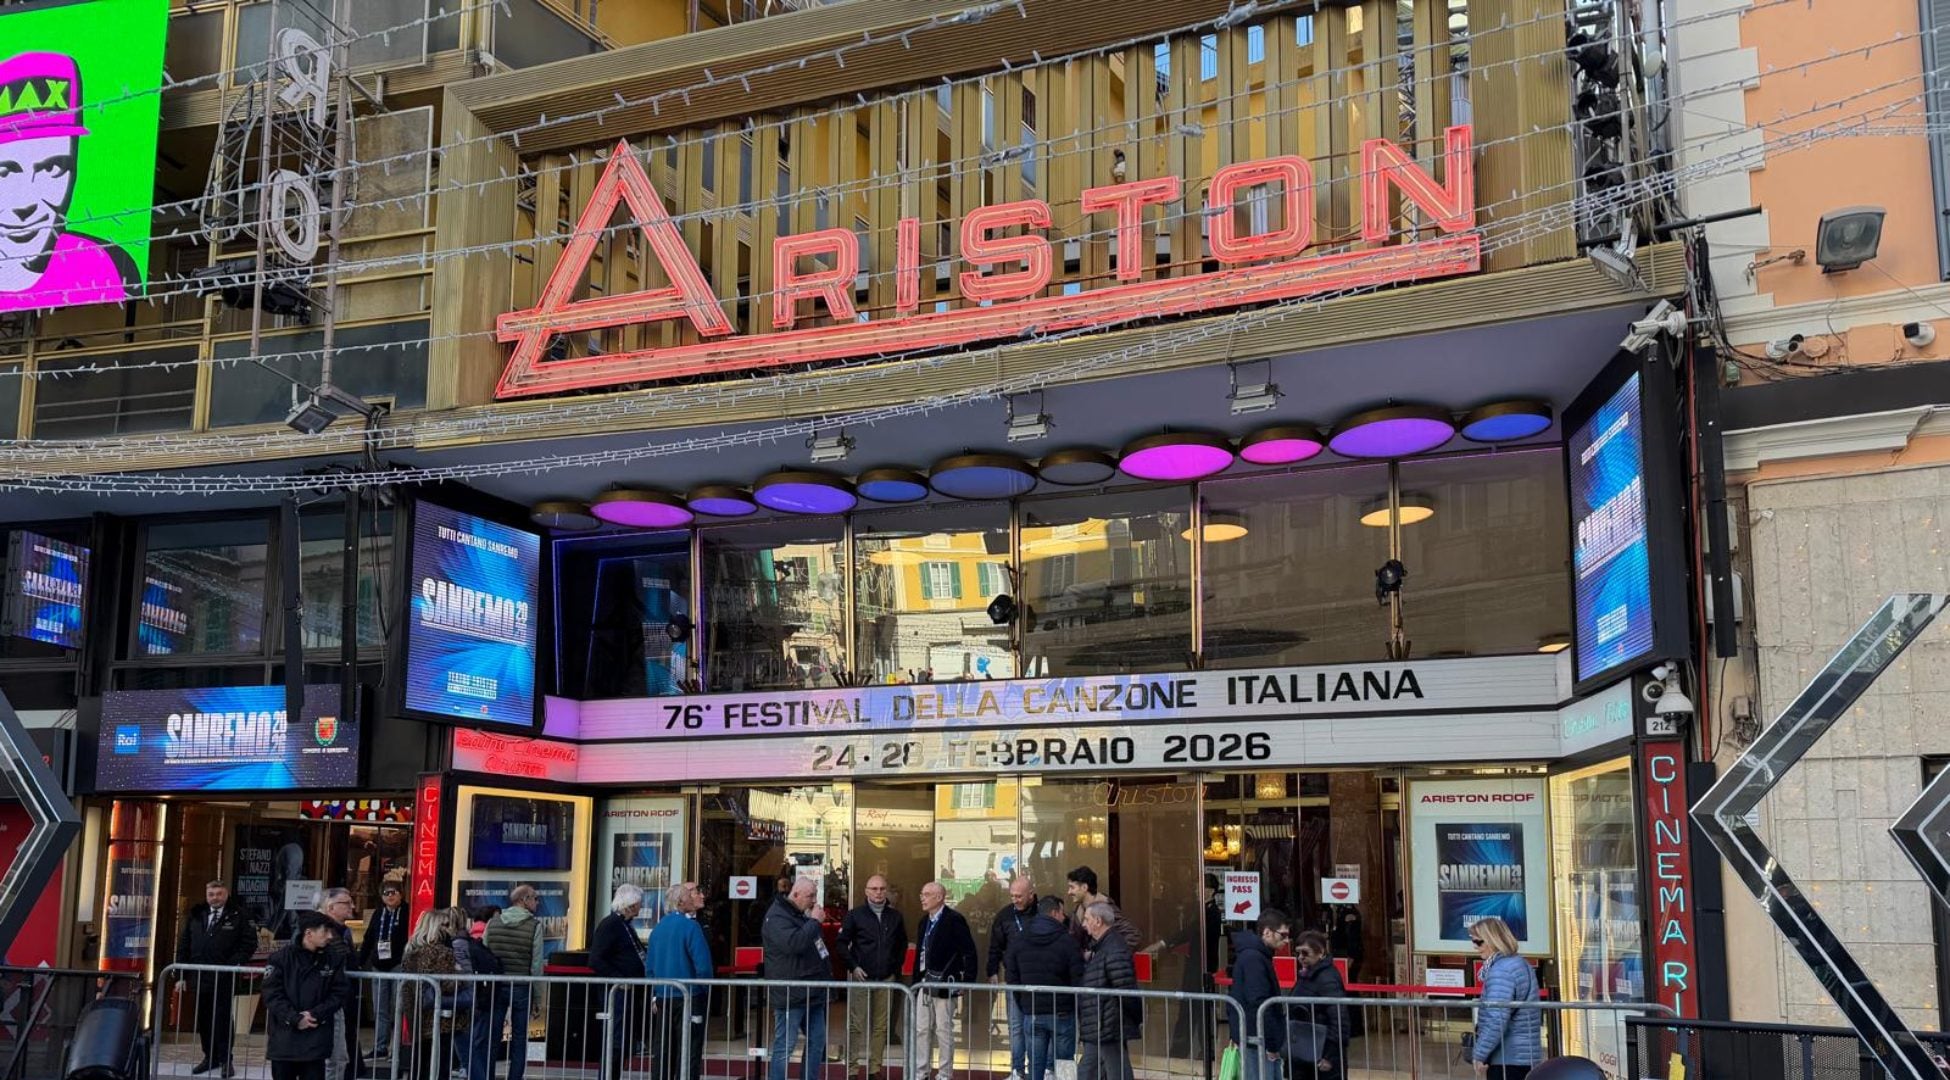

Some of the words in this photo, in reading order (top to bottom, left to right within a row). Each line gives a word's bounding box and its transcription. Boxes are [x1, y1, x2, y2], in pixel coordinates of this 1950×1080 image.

[497, 124, 1481, 400] ARISTON
[421, 577, 514, 640] SANREMO
[724, 697, 871, 729] FESTIVAL
[893, 689, 1001, 721] DELLA
[1023, 680, 1197, 714] CANZONE
[1228, 669, 1424, 705] ITALIANA
[165, 711, 272, 759] SANREMO
[1652, 721, 1672, 732] 212
[117, 733, 137, 747] Rai
[949, 737, 1135, 768] FEBBRAIO
[1163, 732, 1271, 763] 2026
[1421, 794, 1489, 803] ARISTON
[1492, 793, 1535, 802] ROOF
[604, 809, 649, 818] ARISTON
[650, 809, 680, 817] ROOF
[417, 787, 438, 896] CINEMA
[1650, 756, 1688, 945] CINEMA
[240, 848, 271, 861] STEFANO
[613, 866, 662, 887] SANREMO
[1226, 875, 1258, 884] INGRESSO
[1440, 864, 1511, 889] SANREMO
[1232, 885, 1253, 893] PASS
